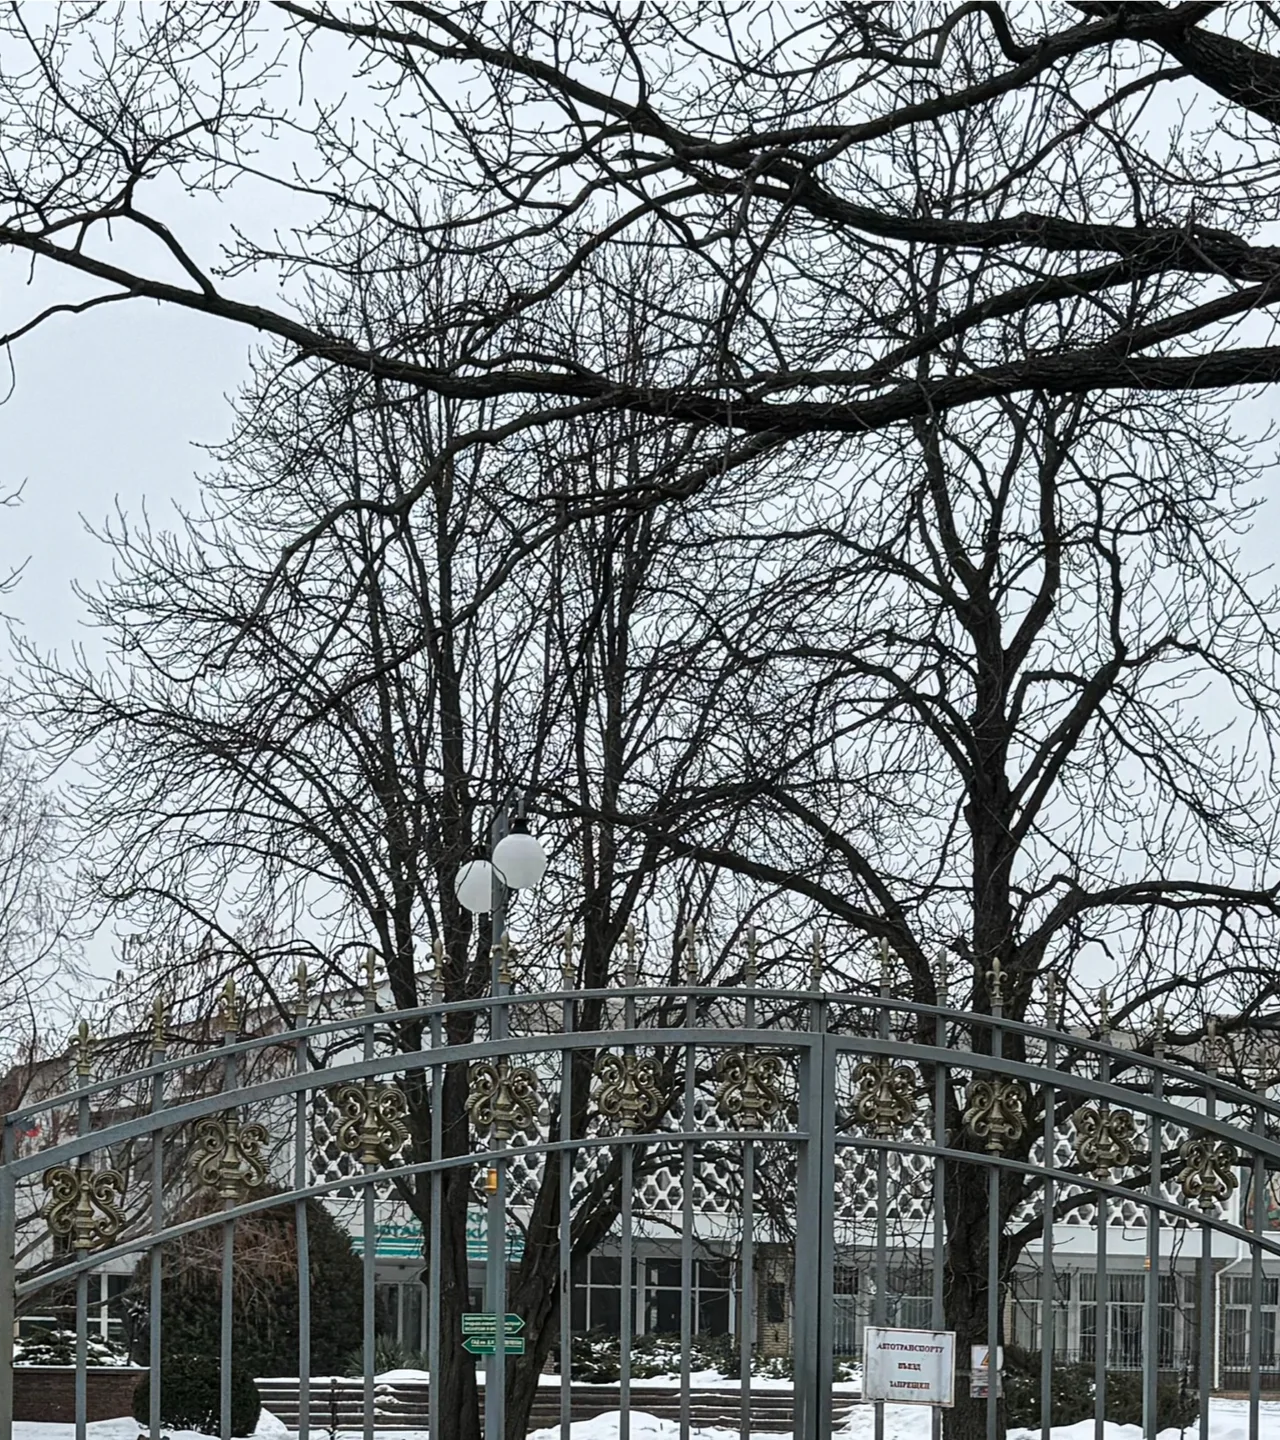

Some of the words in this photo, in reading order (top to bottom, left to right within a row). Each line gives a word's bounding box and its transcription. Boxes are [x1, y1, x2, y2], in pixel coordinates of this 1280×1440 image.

[877, 1343, 944, 1353] АВТОТРАНСПОРТУ
[897, 1362, 922, 1371] ВЪЕЗД
[889, 1380, 930, 1390] ЗАПРЕЩЕН
